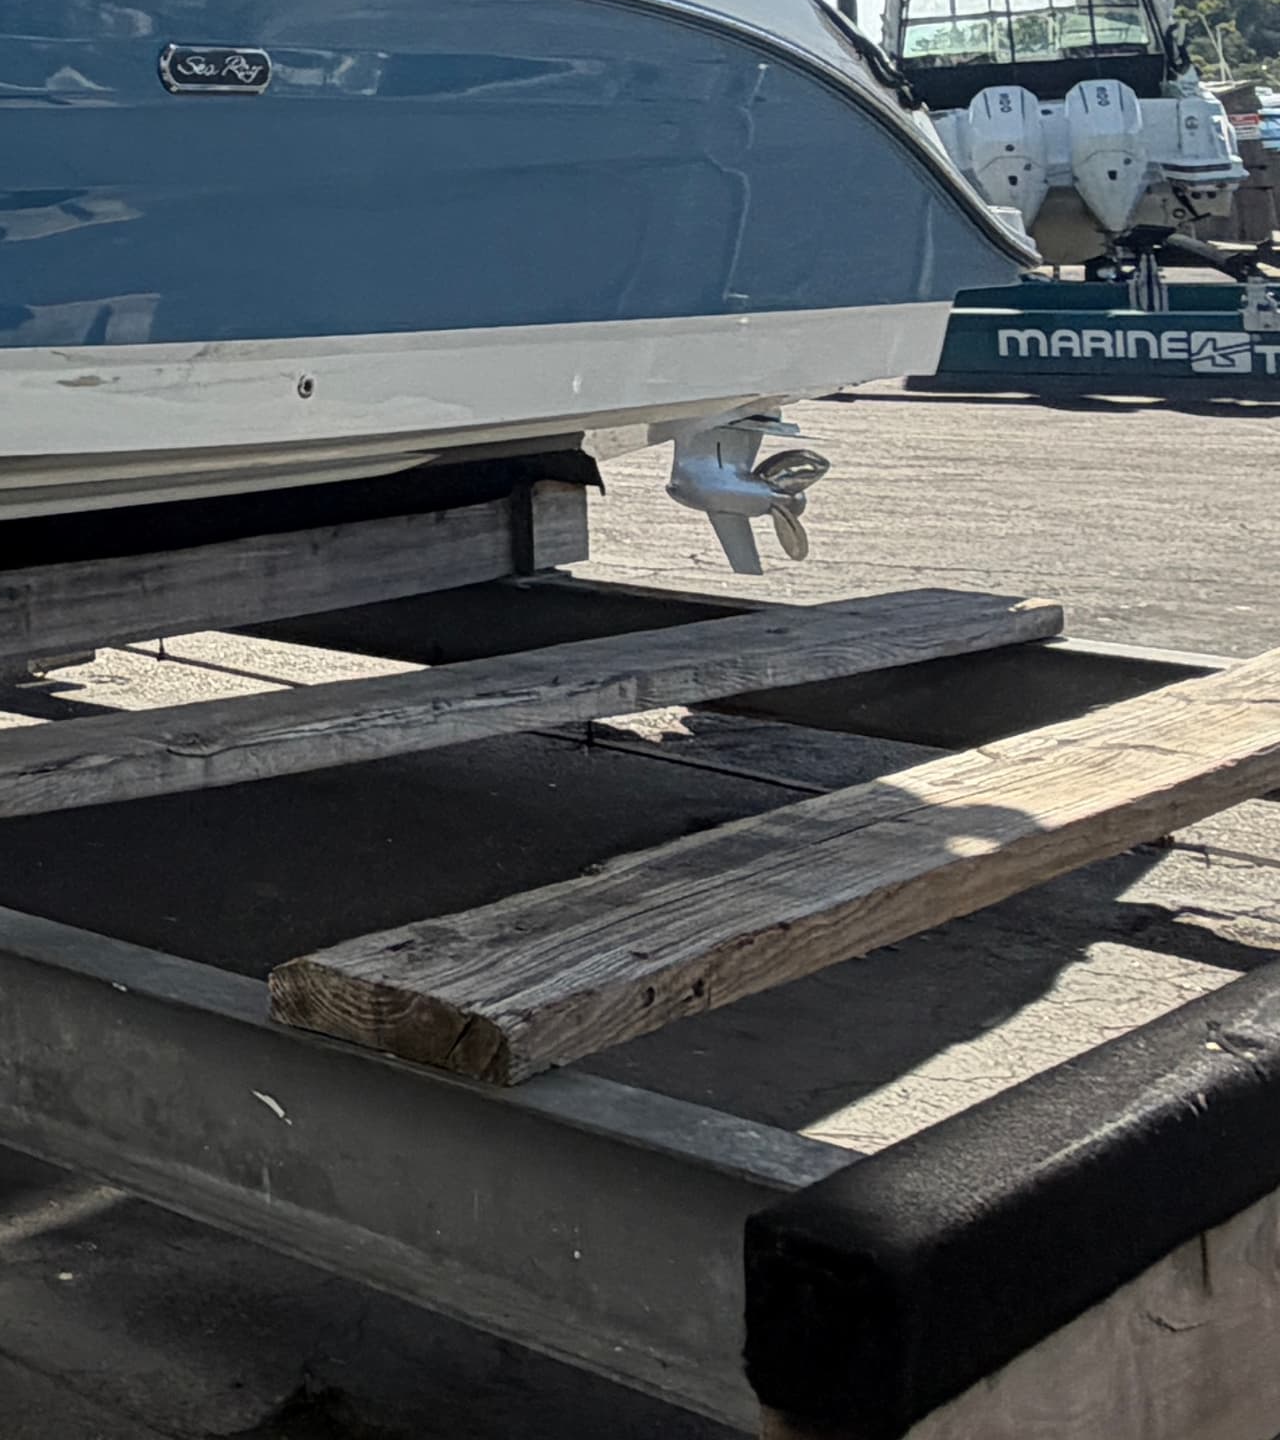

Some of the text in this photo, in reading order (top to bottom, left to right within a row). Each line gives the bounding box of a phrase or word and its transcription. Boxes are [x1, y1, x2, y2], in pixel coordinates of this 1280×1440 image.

[177, 55, 264, 84] Sea Ray
[998, 329, 1189, 359] MARINE
